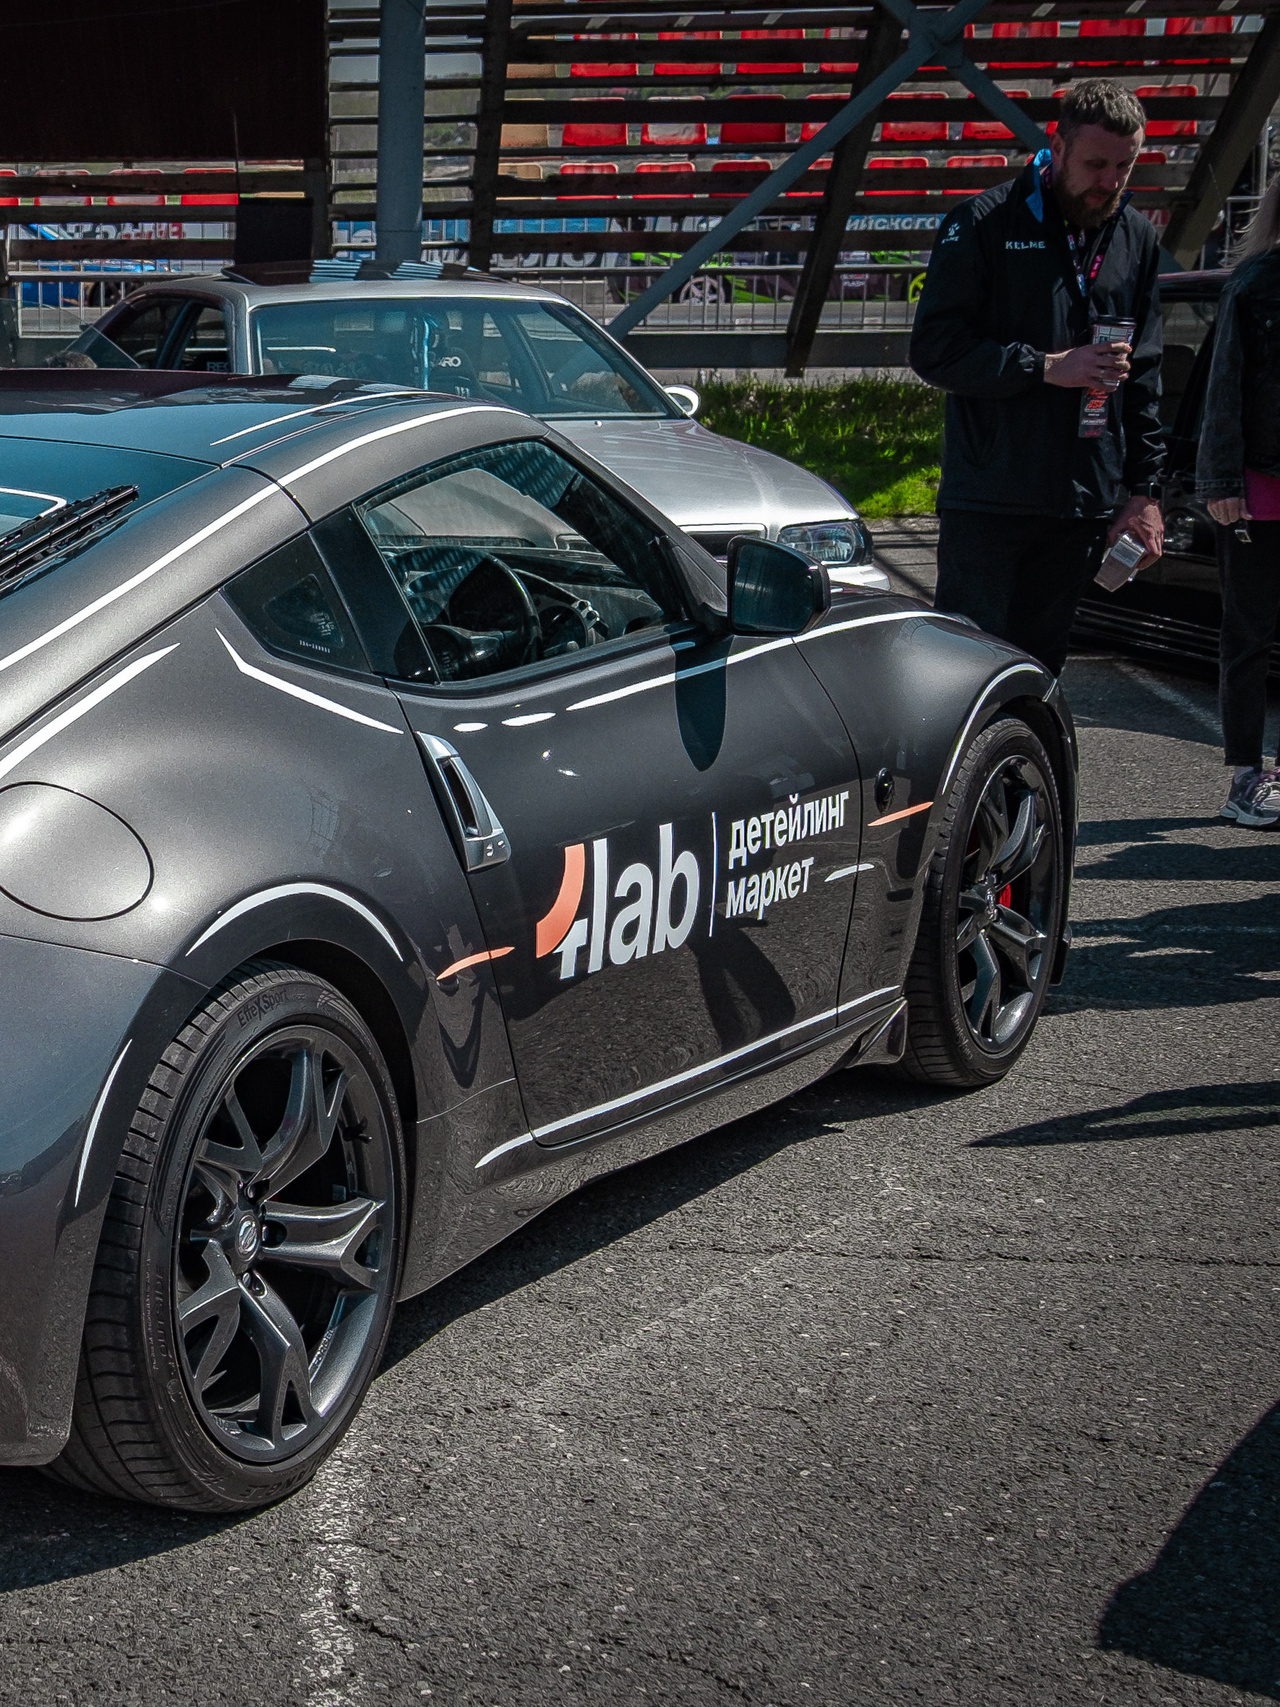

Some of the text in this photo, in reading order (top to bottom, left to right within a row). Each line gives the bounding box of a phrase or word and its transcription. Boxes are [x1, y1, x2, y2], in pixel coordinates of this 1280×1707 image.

[1005, 241, 1046, 250] KELME
[728, 792, 849, 869] детейлинг
[725, 857, 815, 920] маркет
